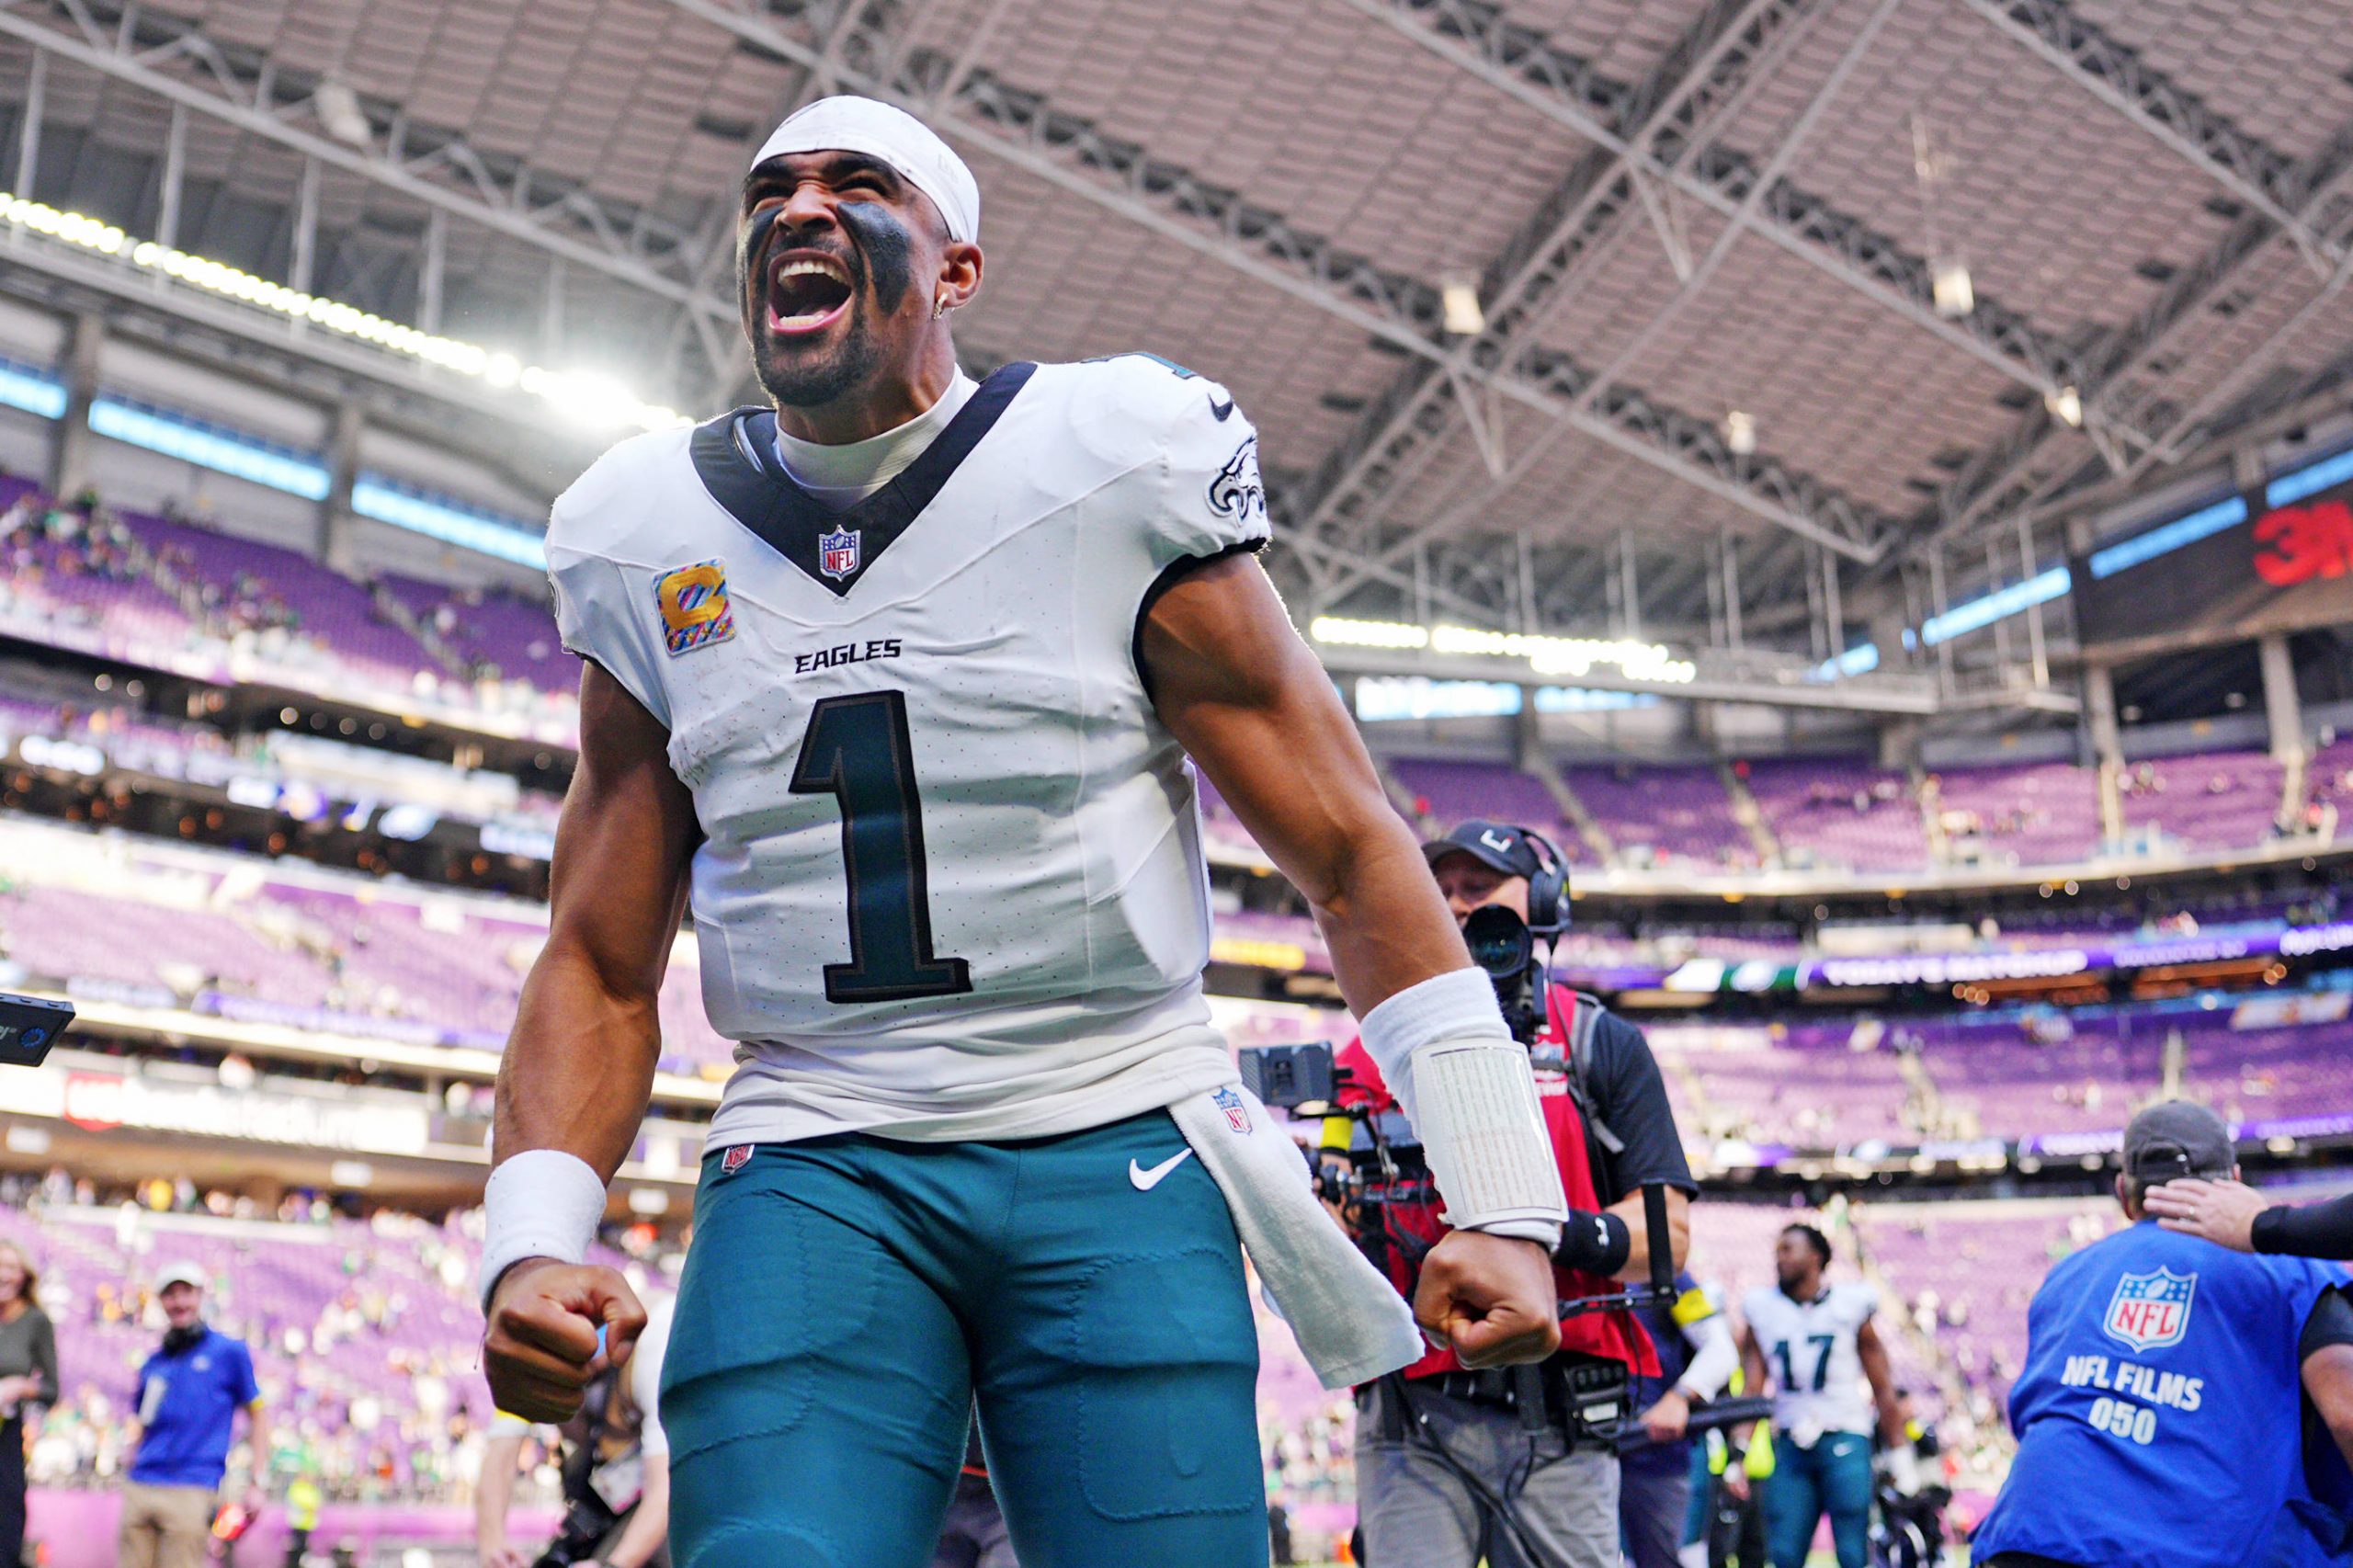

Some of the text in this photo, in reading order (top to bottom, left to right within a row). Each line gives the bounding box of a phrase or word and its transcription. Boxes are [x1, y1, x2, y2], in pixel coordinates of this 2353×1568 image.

[825, 550, 854, 572] NFL
[659, 565, 727, 629] C
[794, 638, 903, 674] EAGLES
[789, 689, 973, 1004] 1
[2117, 1301, 2176, 1338] NFL
[1773, 1335, 1836, 1392] 17
[2060, 1355, 2204, 1412] NFL FILMS
[2087, 1396, 2157, 1445] 050
